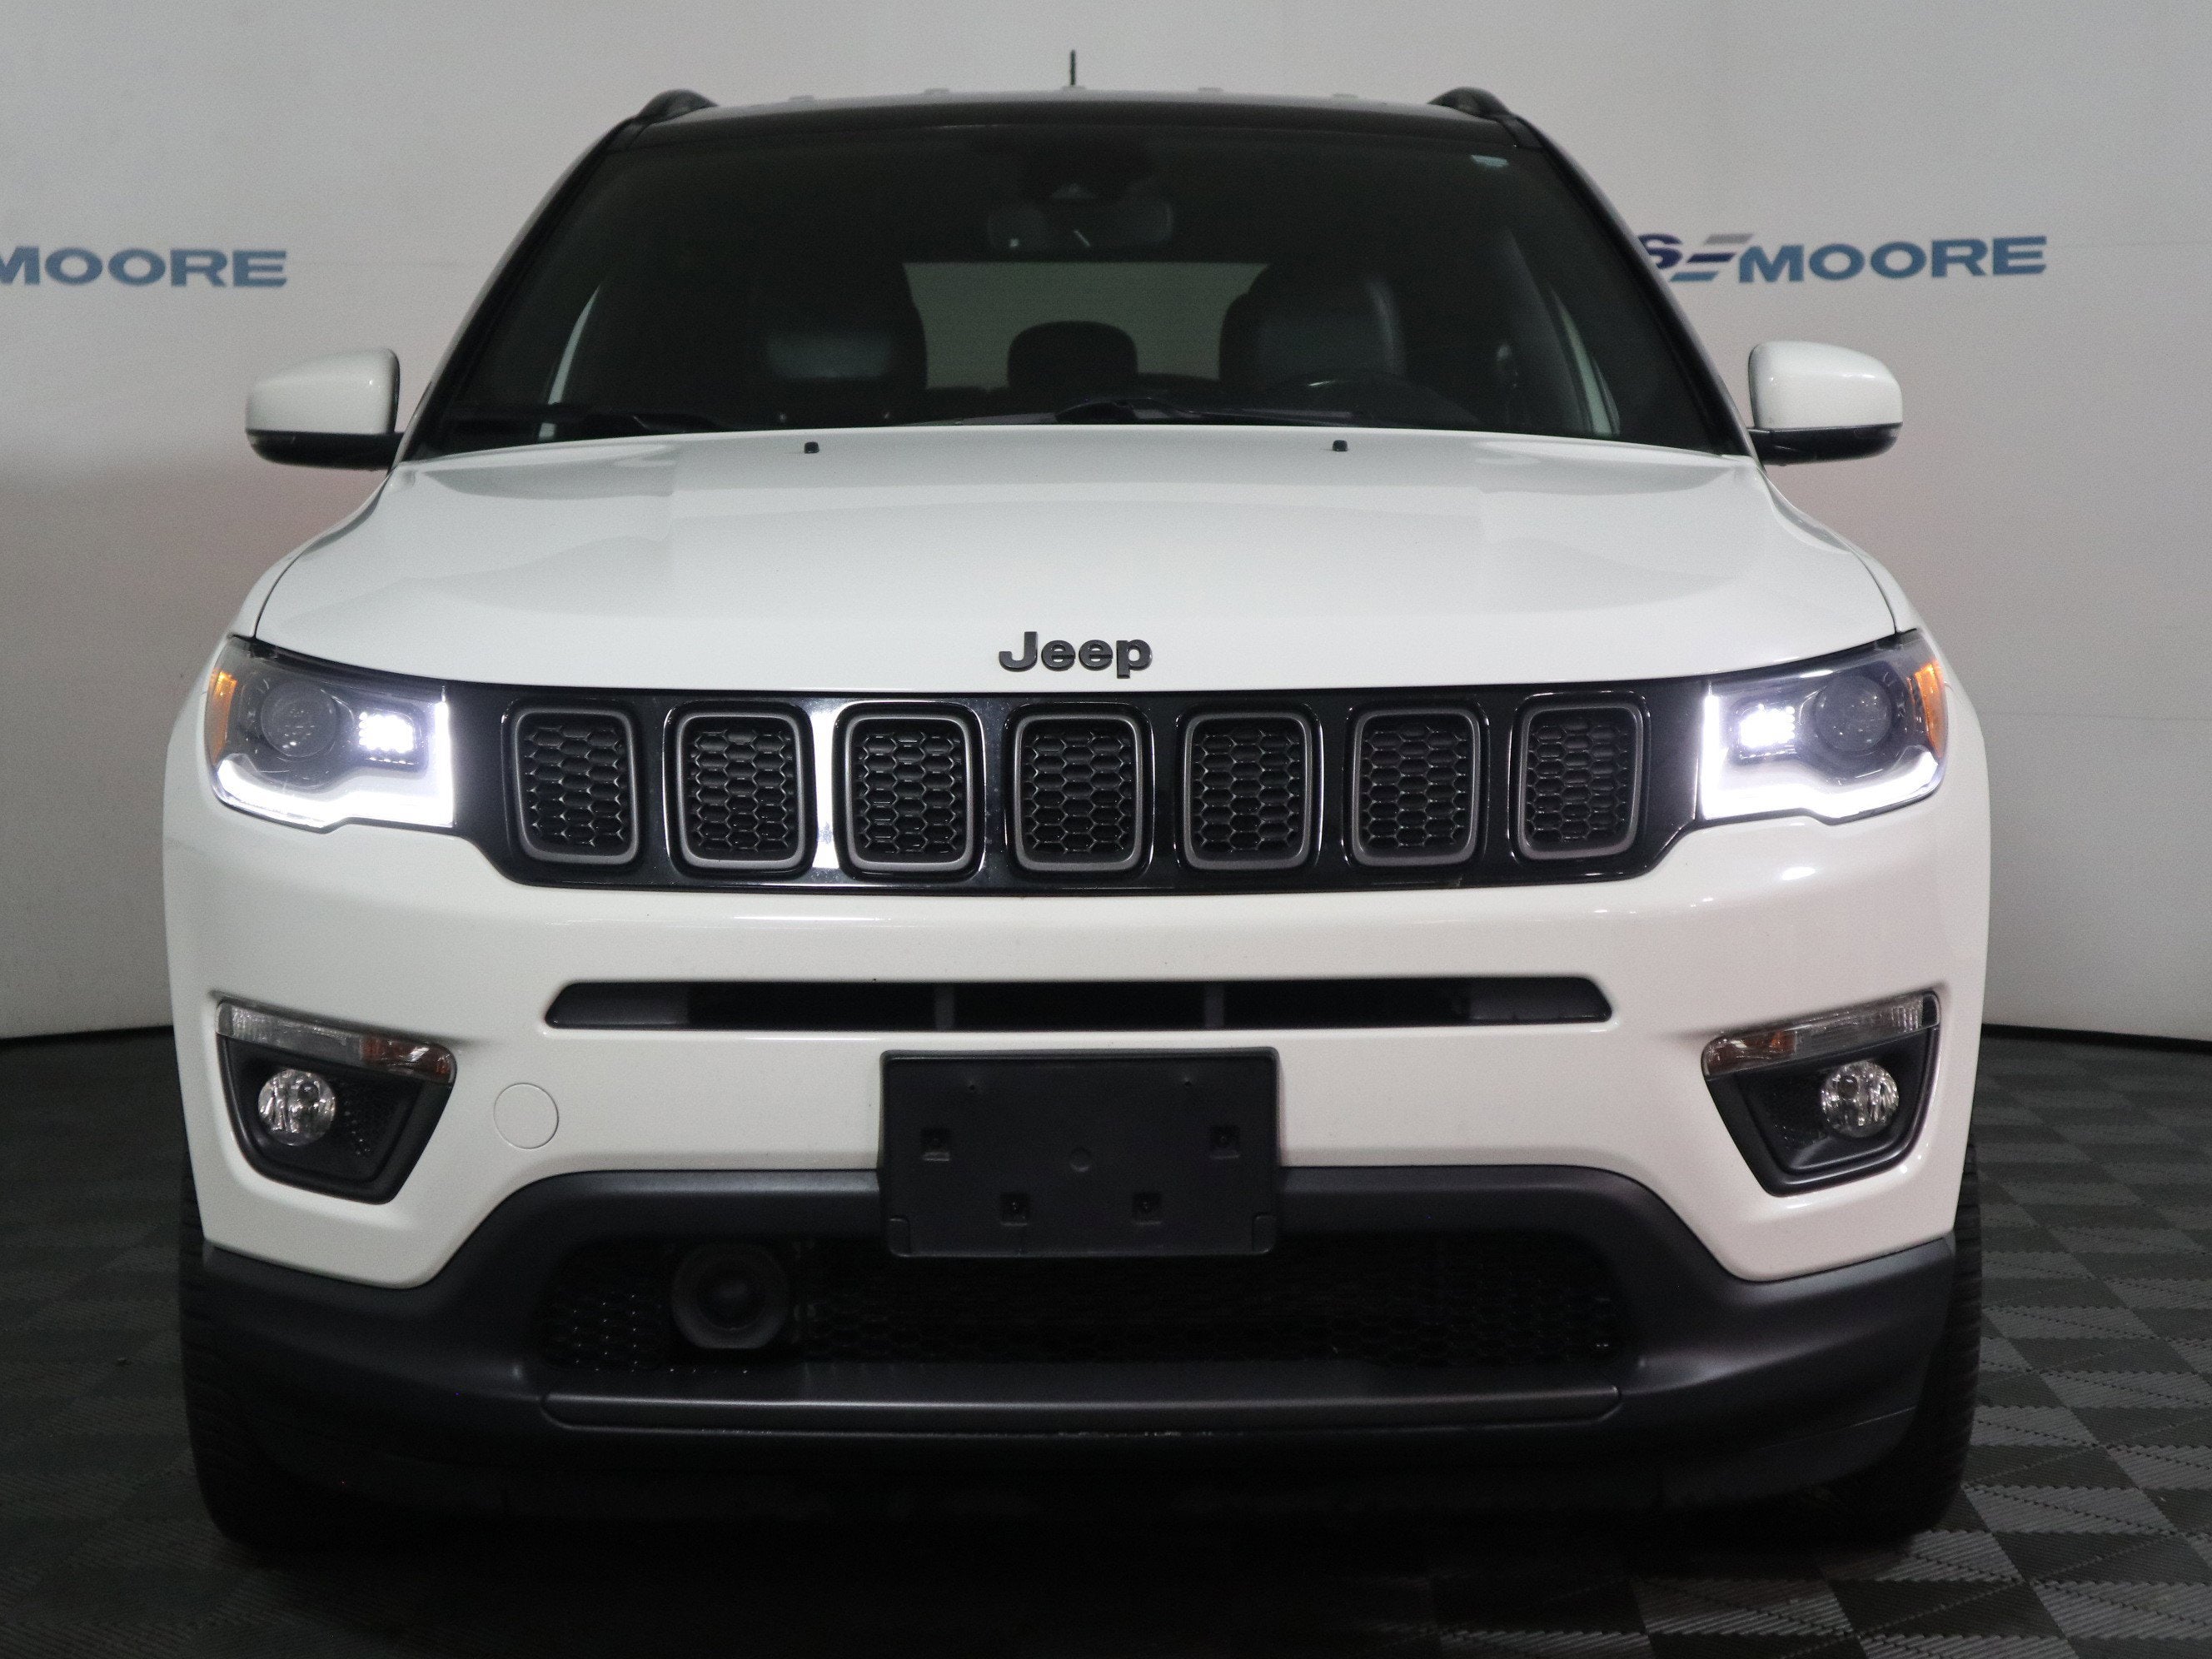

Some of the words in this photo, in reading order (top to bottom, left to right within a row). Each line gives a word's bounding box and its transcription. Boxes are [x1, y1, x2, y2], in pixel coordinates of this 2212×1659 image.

[0, 246, 287, 287] MOORE
[1739, 236, 2047, 283] MOORE
[999, 630, 1153, 679] Jeep
